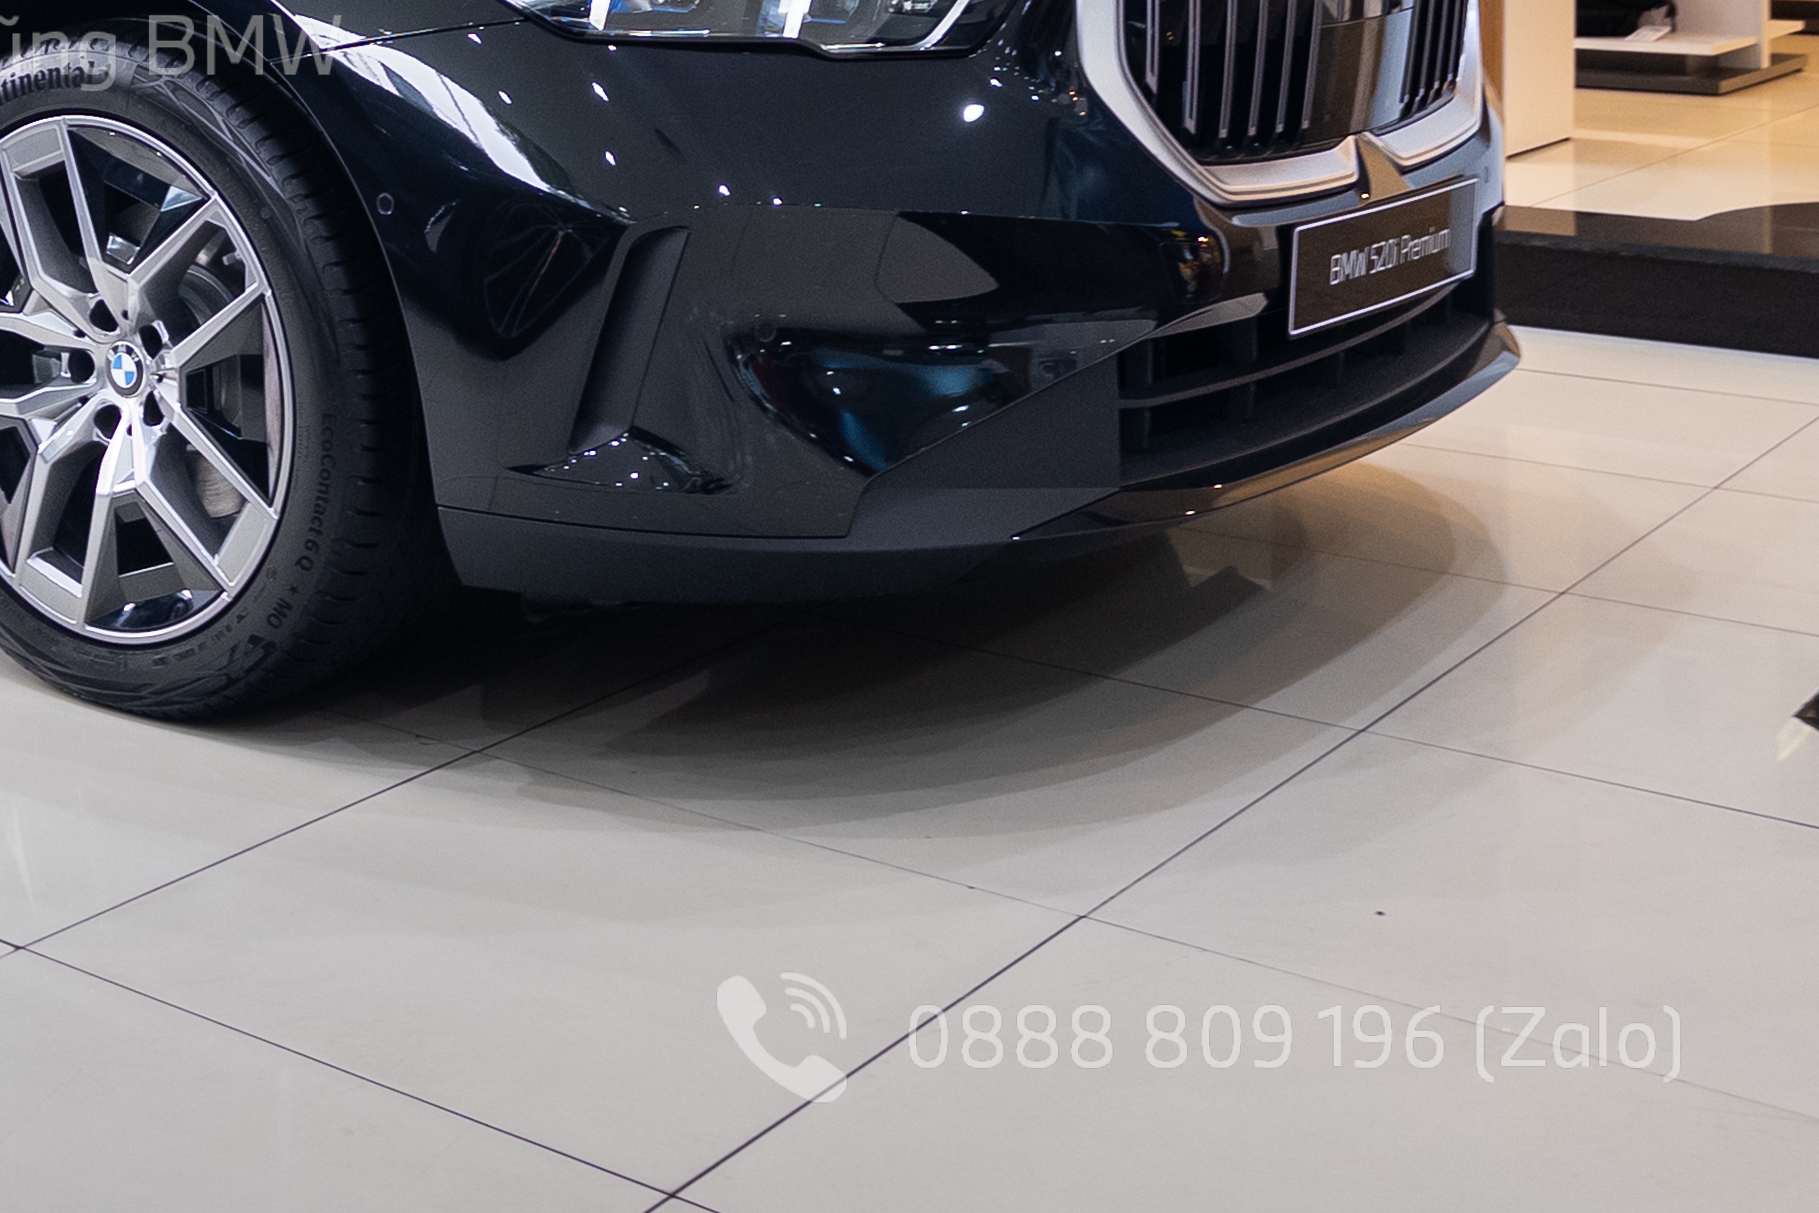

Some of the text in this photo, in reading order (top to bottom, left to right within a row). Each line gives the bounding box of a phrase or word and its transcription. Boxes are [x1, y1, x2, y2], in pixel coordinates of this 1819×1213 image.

[1329, 226, 1451, 285] BMW 520i Premium
[310, 413, 336, 537] EcoContact
